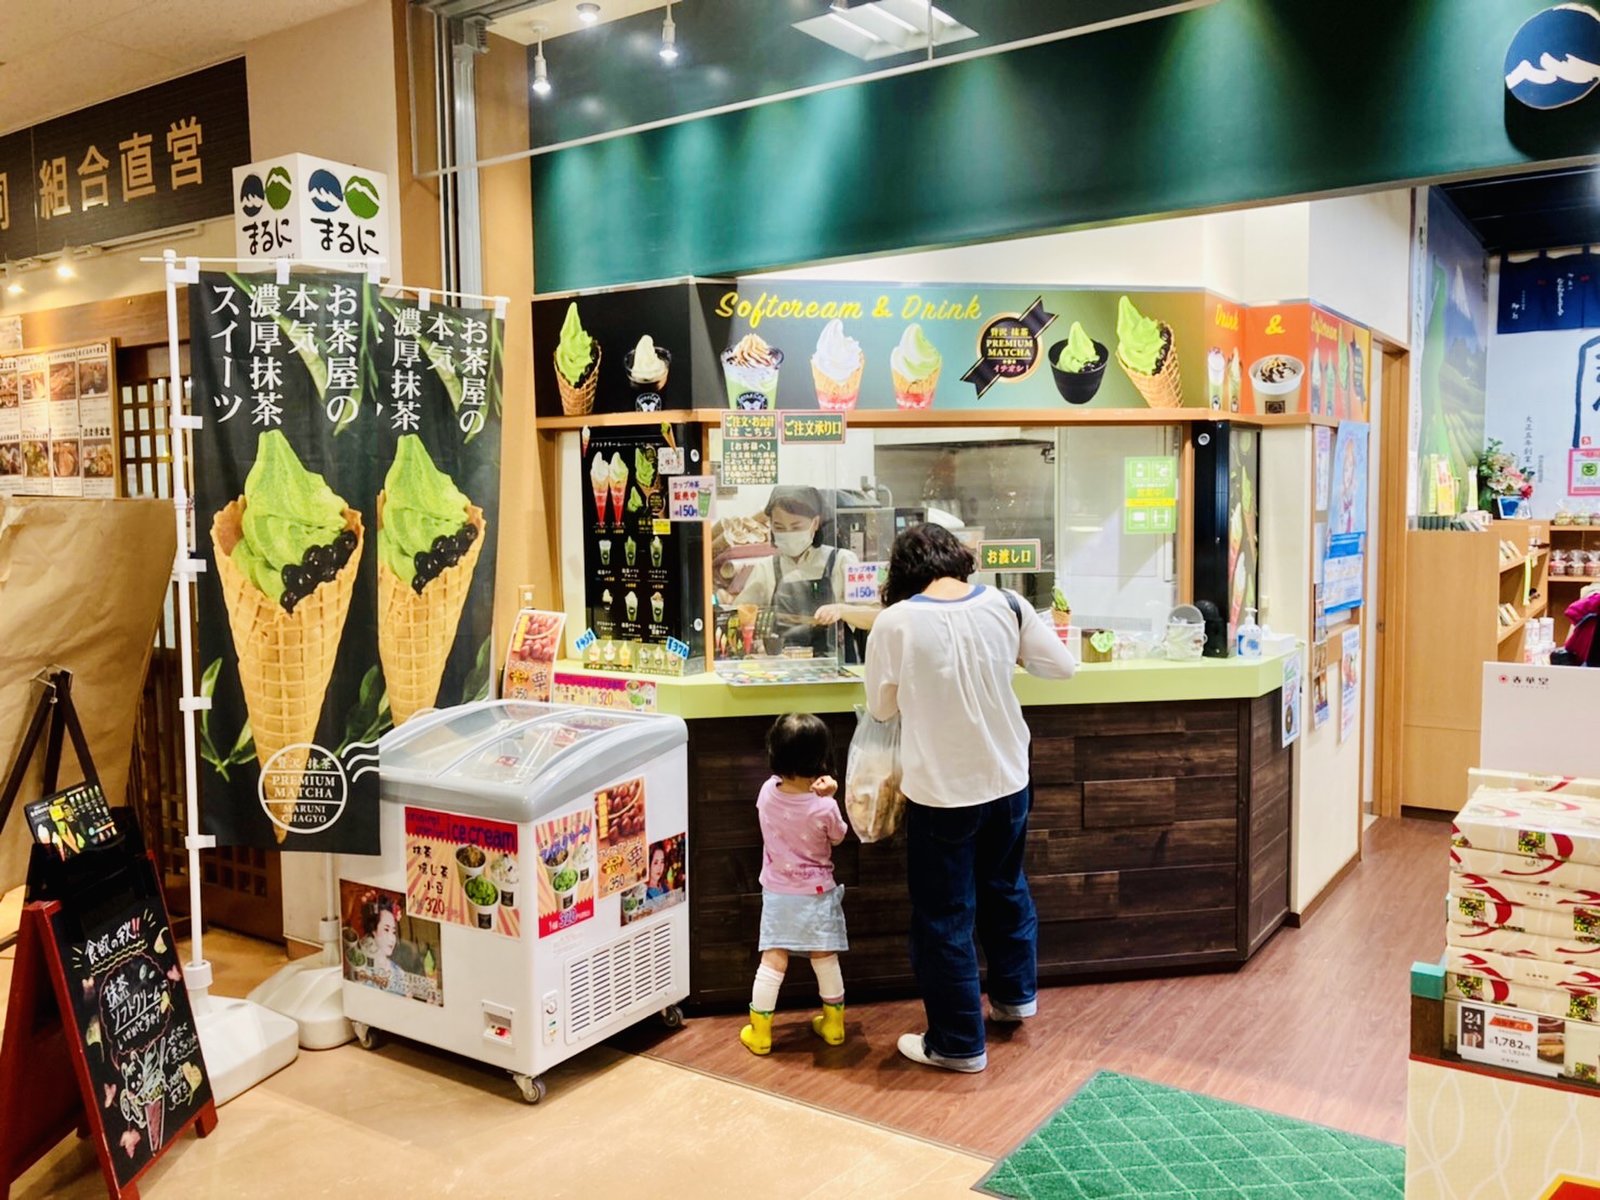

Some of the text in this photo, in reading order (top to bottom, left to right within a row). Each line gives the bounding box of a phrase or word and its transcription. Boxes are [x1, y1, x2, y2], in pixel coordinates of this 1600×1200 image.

[39, 116, 203, 220] 組合直営
[242, 217, 292, 256] まるに
[310, 217, 380, 256] まるに
[287, 283, 319, 355] 本気
[715, 291, 982, 329] Softcream & Drink
[1264, 314, 1286, 336] &
[211, 284, 243, 423] スイーツ
[249, 283, 284, 426] 濃厚抹茶
[325, 283, 359, 424] お茶屋の
[426, 312, 456, 374] 本気
[986, 339, 1033, 348] PREMIUM
[987, 348, 1031, 357] MATCHA
[391, 307, 421, 432] 濃厚抹茶
[459, 317, 489, 434] お茶屋の
[986, 549, 1031, 565] お渡し口
[272, 775, 335, 787] PREMIUM
[274, 787, 333, 799] MATCHA
[281, 813, 327, 823] CHAGYO
[283, 804, 326, 813] MARUNI
[468, 825, 516, 852] cream
[424, 896, 445, 915] 320
[103, 973, 130, 1008] 抹茶
[110, 986, 161, 1032] ソフトクリーム
[1464, 1011, 1481, 1025] 24
